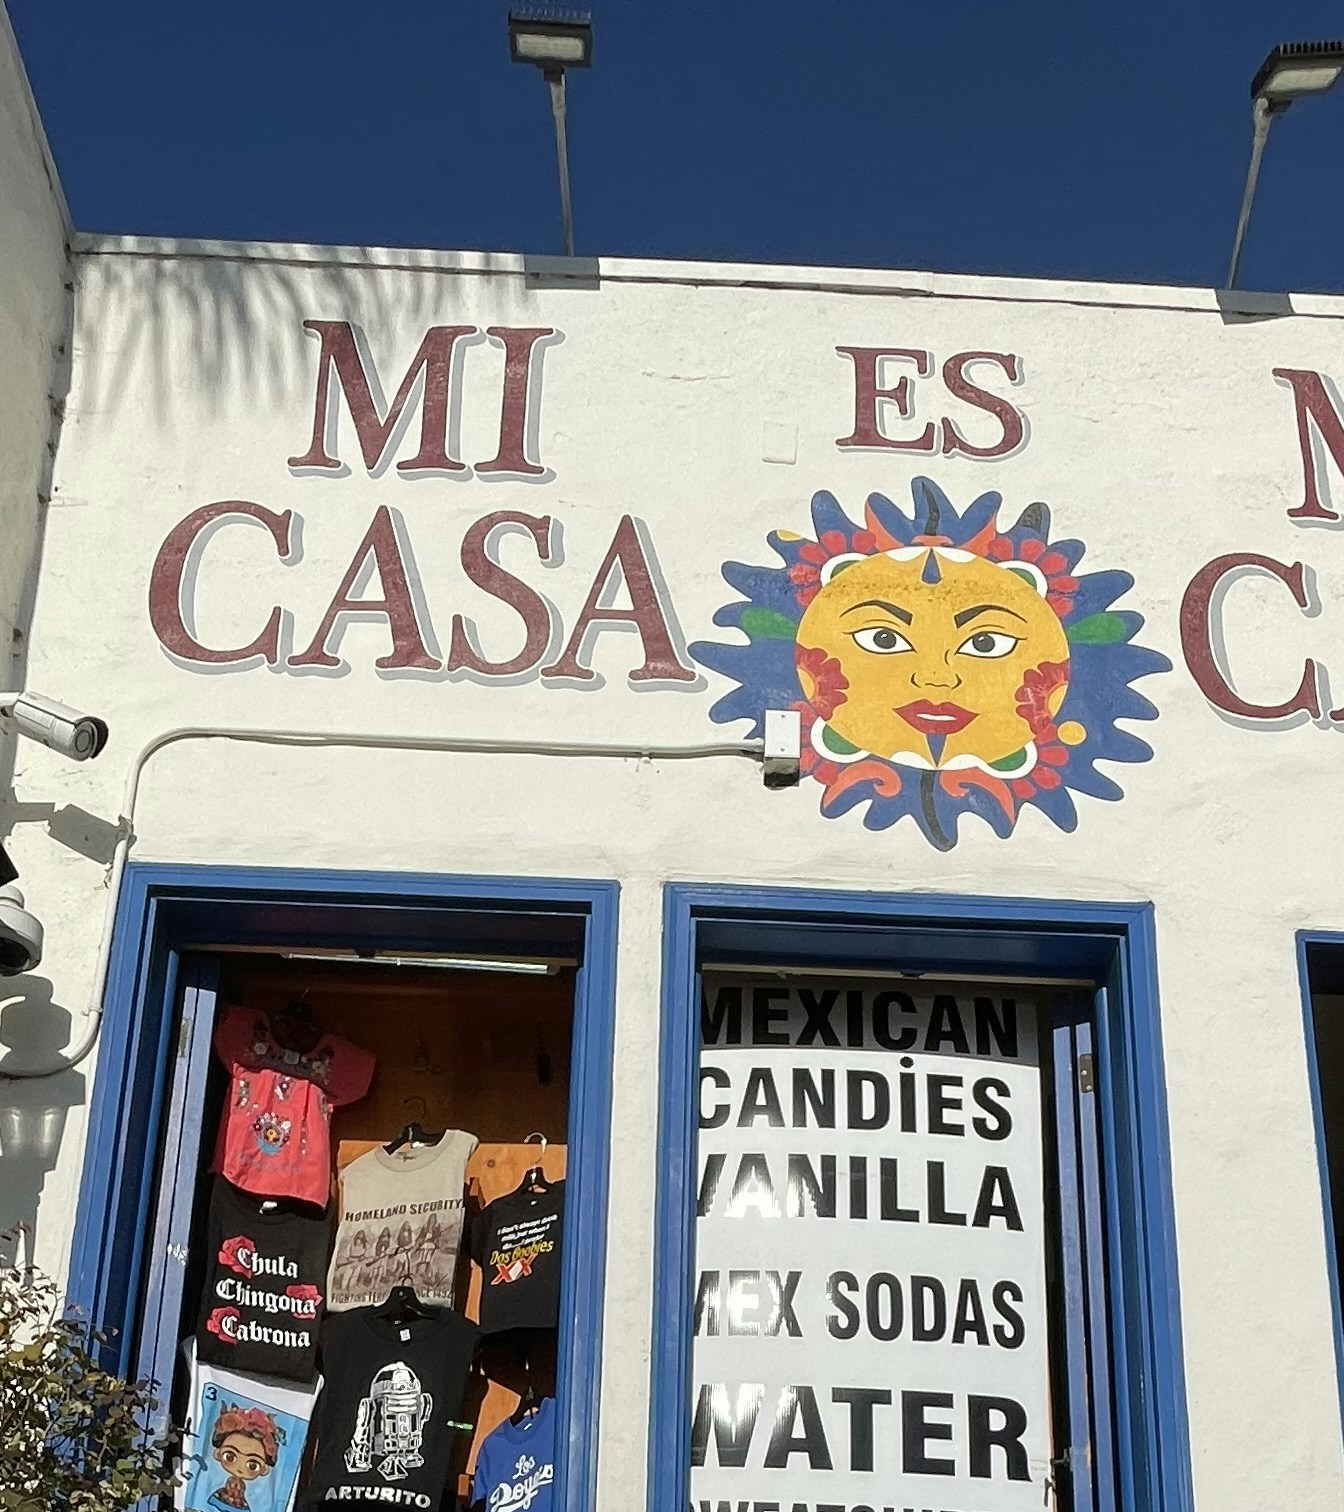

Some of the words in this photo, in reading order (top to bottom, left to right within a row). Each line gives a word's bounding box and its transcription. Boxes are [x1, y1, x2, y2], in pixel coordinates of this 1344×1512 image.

[287, 318, 561, 480] MI
[834, 344, 1028, 460] ES
[148, 499, 704, 690] CASA
[700, 986, 1019, 1058] MEXICAN
[344, 1203, 407, 1222] HOMELAND
[409, 1198, 463, 1215] SECURITY
[237, 1247, 298, 1279] Chula
[215, 1277, 317, 1314] Chingona
[824, 1269, 1027, 1350] SODAS
[221, 1315, 311, 1348] Cabrona
[205, 1386, 218, 1401] 3
[691, 1383, 1034, 1483] WATER
[324, 1485, 432, 1509] ARTURITO
